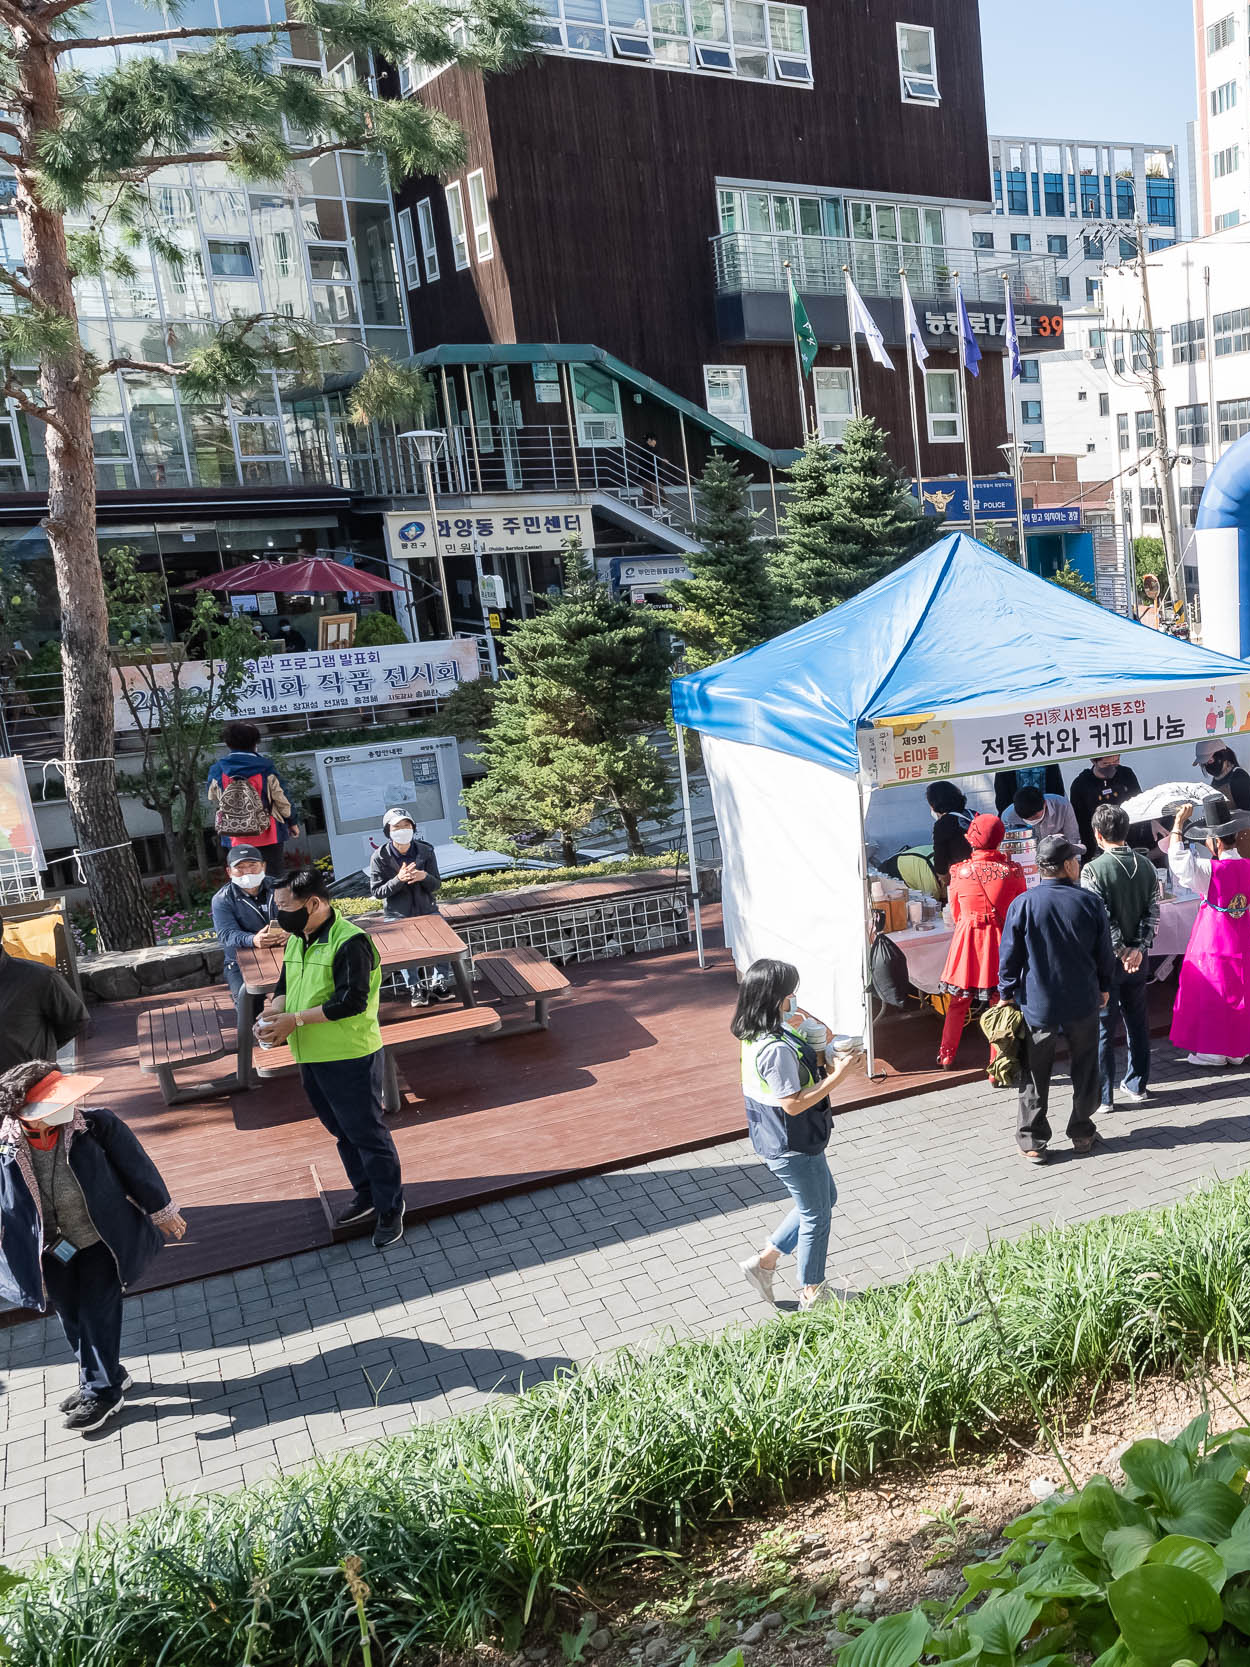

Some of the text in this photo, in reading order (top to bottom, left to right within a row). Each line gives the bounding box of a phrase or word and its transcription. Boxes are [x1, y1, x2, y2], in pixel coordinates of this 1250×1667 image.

[925, 312, 1063, 337] 능동로17길 39
[963, 499, 1006, 511] 경찰 POLICE
[437, 514, 581, 537] 화양동 주민센터
[1031, 513, 1043, 523] 믿고
[1068, 511, 1079, 521] 경찰
[280, 655, 335, 671] 프로그램
[340, 651, 381, 667] 발표회
[233, 675, 308, 700] 채화
[317, 669, 374, 695] 작품
[383, 660, 460, 688] 전시회
[1023, 699, 1146, 728] 우리家사회적협동조합
[902, 734, 926, 746] 제9회
[981, 714, 1186, 766] 전통차와 커피 나눔
[895, 761, 950, 780] 마당 축제
